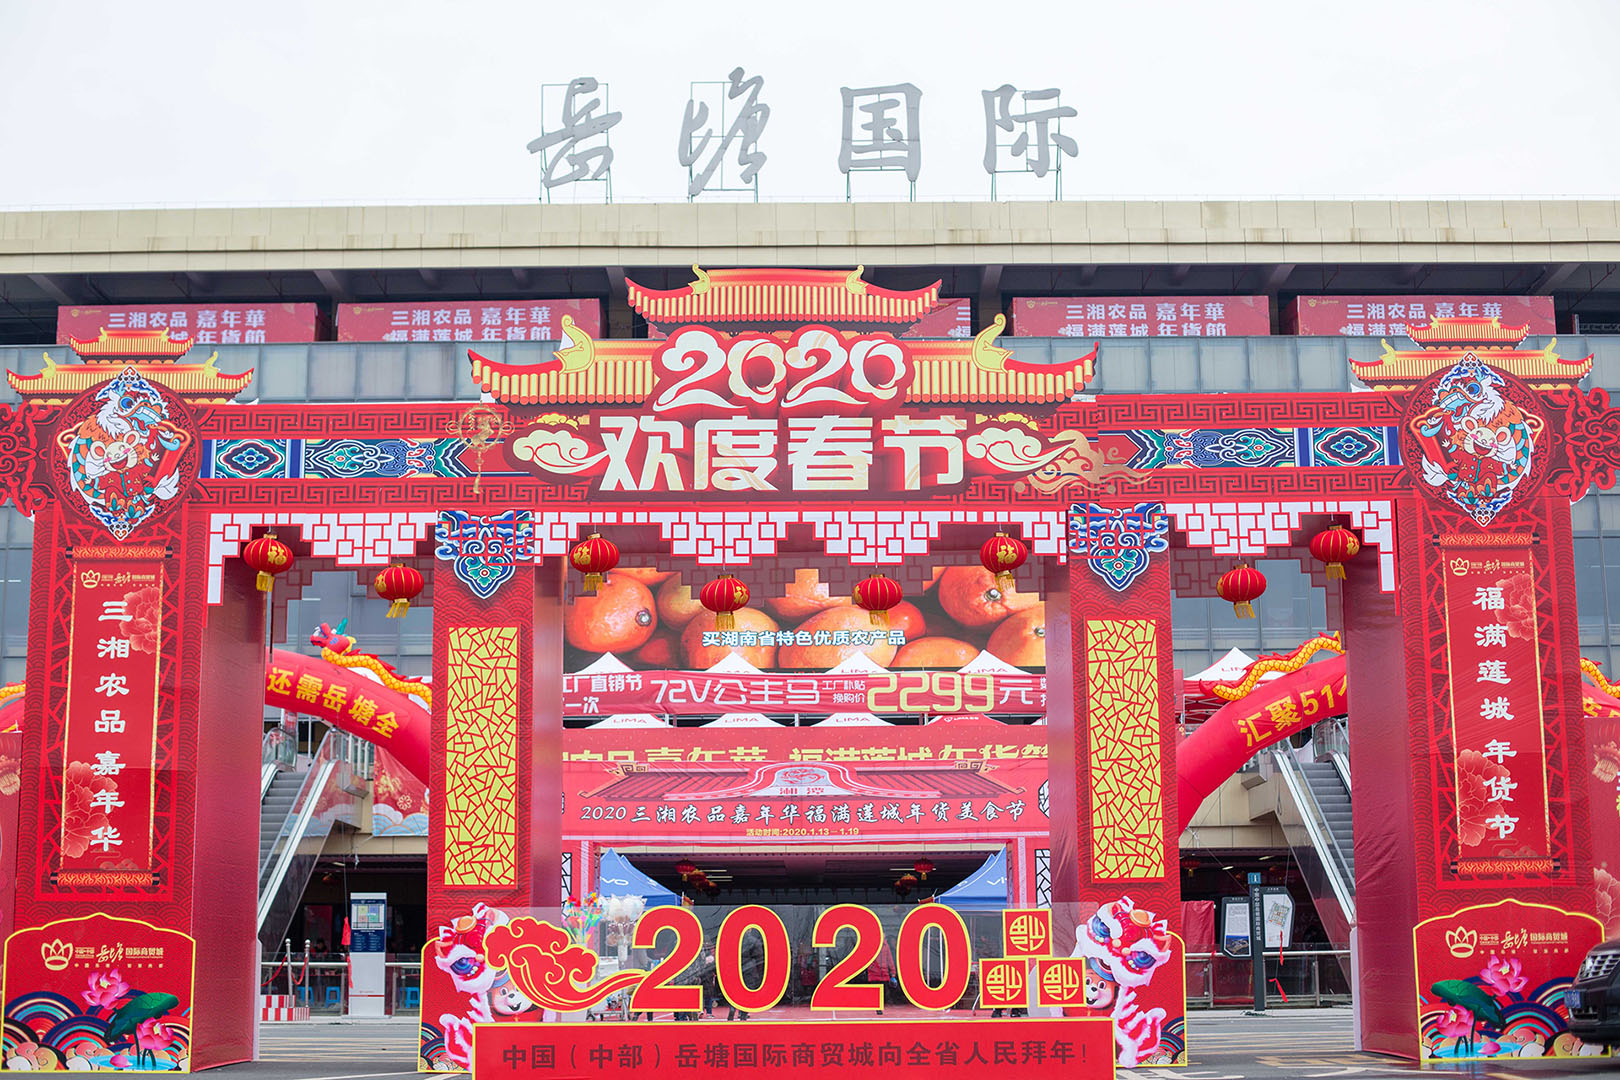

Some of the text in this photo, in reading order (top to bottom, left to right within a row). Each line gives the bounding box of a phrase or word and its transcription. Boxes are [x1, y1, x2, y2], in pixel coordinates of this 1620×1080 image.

[107, 309, 266, 328] 三湘农品 嘉年華
[390, 306, 551, 326] 三湘农品 嘉年華
[1065, 303, 1226, 321] 三湘农品 嘉年華
[1347, 303, 1426, 320] 三湘农品
[1347, 323, 1428, 336] 福满莲
[652, 329, 906, 412] 2020
[599, 415, 967, 491] 欢度春节
[701, 630, 907, 648] 买湖南省特色优质农产品
[266, 667, 399, 739] 还需岳塘全
[650, 679, 820, 705] 72V公主马
[563, 696, 599, 714] 一次
[1472, 586, 1519, 839] 福满莲城年货节
[90, 601, 133, 852] 三湘农品嘉年华
[630, 903, 972, 1013] 2020
